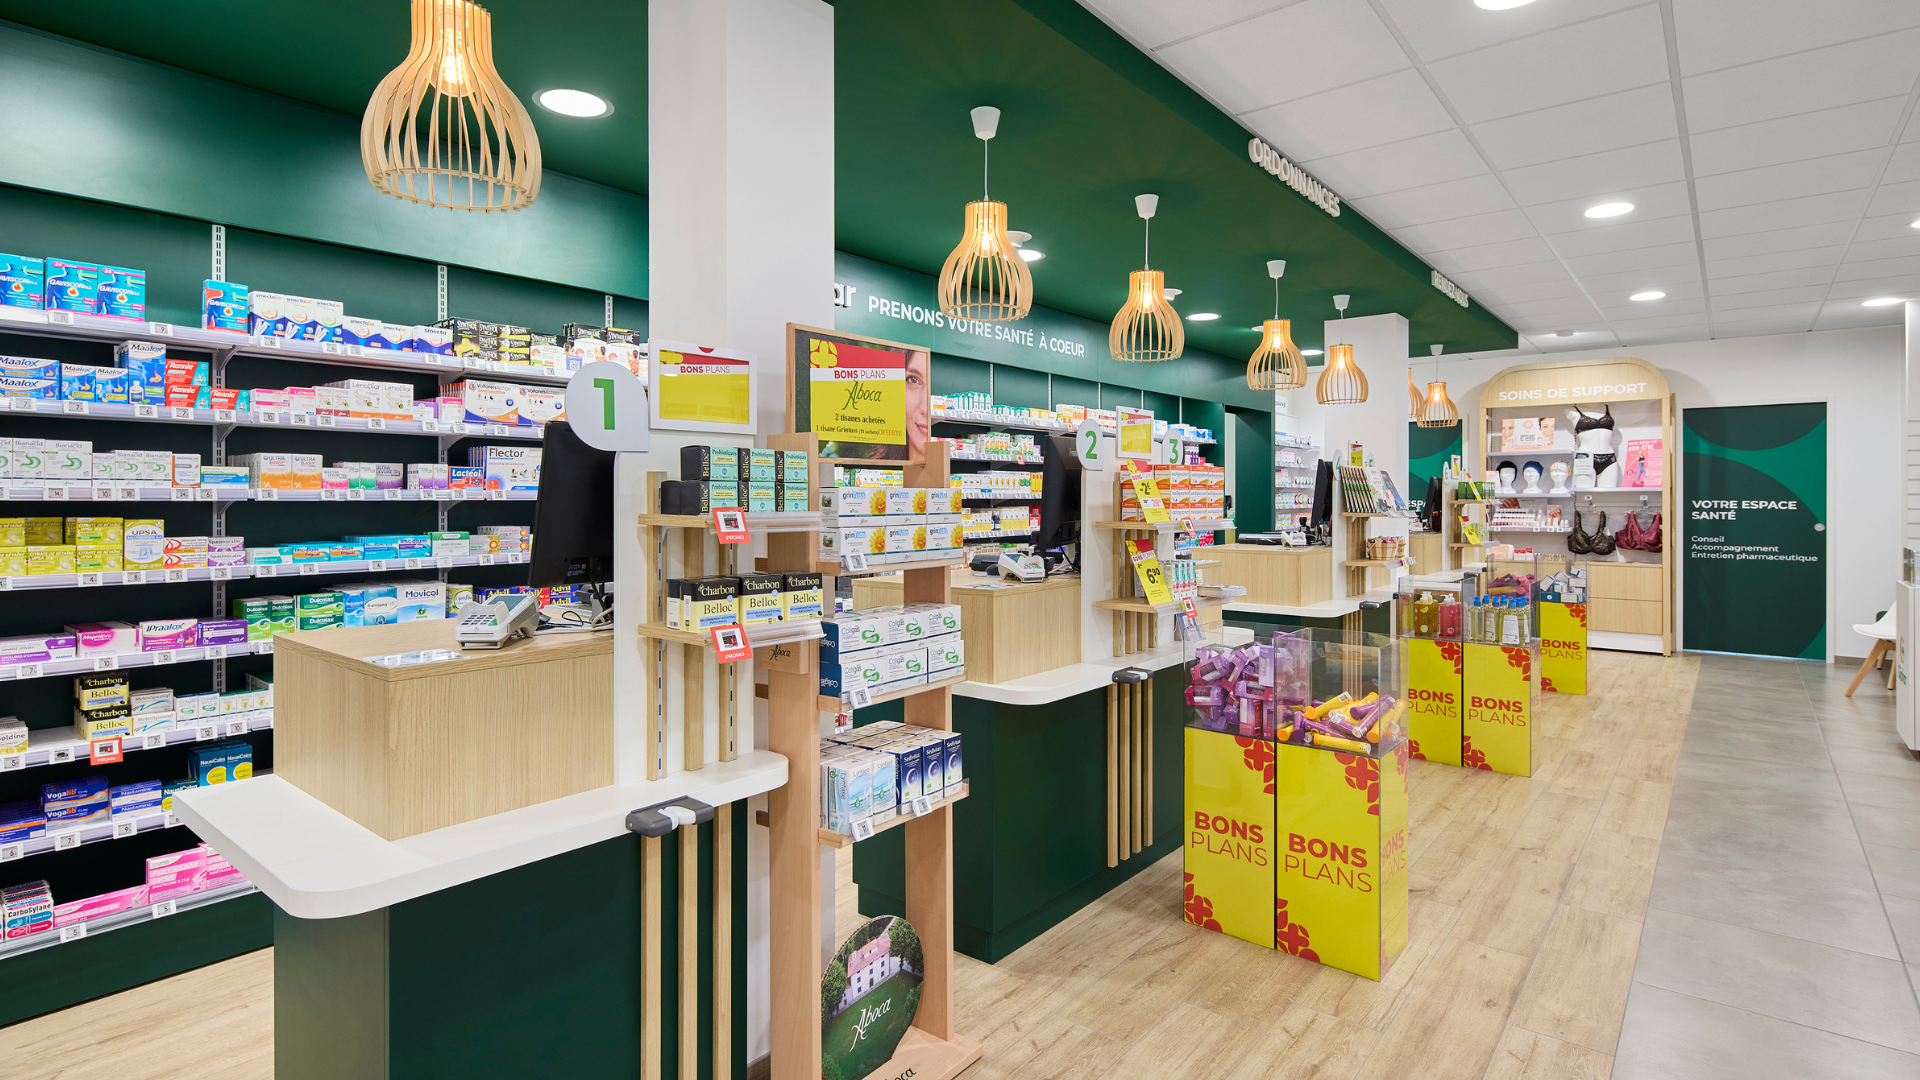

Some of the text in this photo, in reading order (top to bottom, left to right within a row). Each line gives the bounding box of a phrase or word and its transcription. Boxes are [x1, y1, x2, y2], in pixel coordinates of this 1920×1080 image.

[1248, 137, 1341, 218] ORDONNANCES
[868, 295, 1085, 358] PRENONS VOTRE SANTÉ À COEUR
[131, 344, 164, 352] Maalox
[0, 357, 39, 367] Maalox
[170, 362, 194, 370] Rennie
[64, 365, 92, 373] Maalox
[680, 365, 730, 374] BONS PLANS
[834, 370, 886, 379] BONS PLANS
[0, 378, 39, 388] Maalox
[171, 386, 196, 394] Rennie
[213, 390, 236, 398] Rennie
[841, 379, 882, 410] Aboca
[1499, 382, 1647, 401] SOINS DE SUPPORT
[594, 377, 615, 430] 1
[835, 413, 839, 421] 2
[862, 416, 885, 424] achetées
[1085, 430, 1098, 460] 2
[489, 448, 524, 458] Flector
[1169, 438, 1179, 464] 3
[452, 468, 481, 477] Lactéol
[1692, 500, 1797, 510] VOTRE ESPACE
[1691, 510, 1736, 520] SANTÉ
[1691, 544, 1779, 552] Accompagnement
[1737, 553, 1818, 562] pharmaceutique
[746, 580, 780, 591] Charbon
[790, 577, 819, 587] Charbon
[405, 588, 438, 598] Movicol
[551, 585, 571, 593] Advil
[701, 586, 735, 596] Charbon
[750, 597, 777, 608] Belloc
[793, 593, 818, 604] Belloc
[704, 604, 733, 614] Belloc
[1542, 639, 1580, 650] BONS
[769, 644, 791, 661] Aboca
[1541, 648, 1583, 660] PLANS
[88, 677, 123, 686] Charbon
[91, 688, 120, 698] Belloc
[1408, 688, 1454, 704] BONS
[1471, 696, 1523, 713] BONS
[93, 708, 128, 718] Charbon
[1469, 709, 1526, 727] PLANS
[96, 720, 125, 730] Belloc
[47, 789, 77, 799] Vogalib
[47, 807, 77, 817] Vogalib
[1194, 811, 1264, 844] BONS
[1191, 831, 1268, 866] PLANS
[1288, 833, 1368, 868] BONS
[152, 860, 199, 877] POLYSILANE
[1285, 854, 1372, 893] PLANS
[8, 903, 51, 917] CarboSylane
[849, 997, 891, 1052] Aboca
